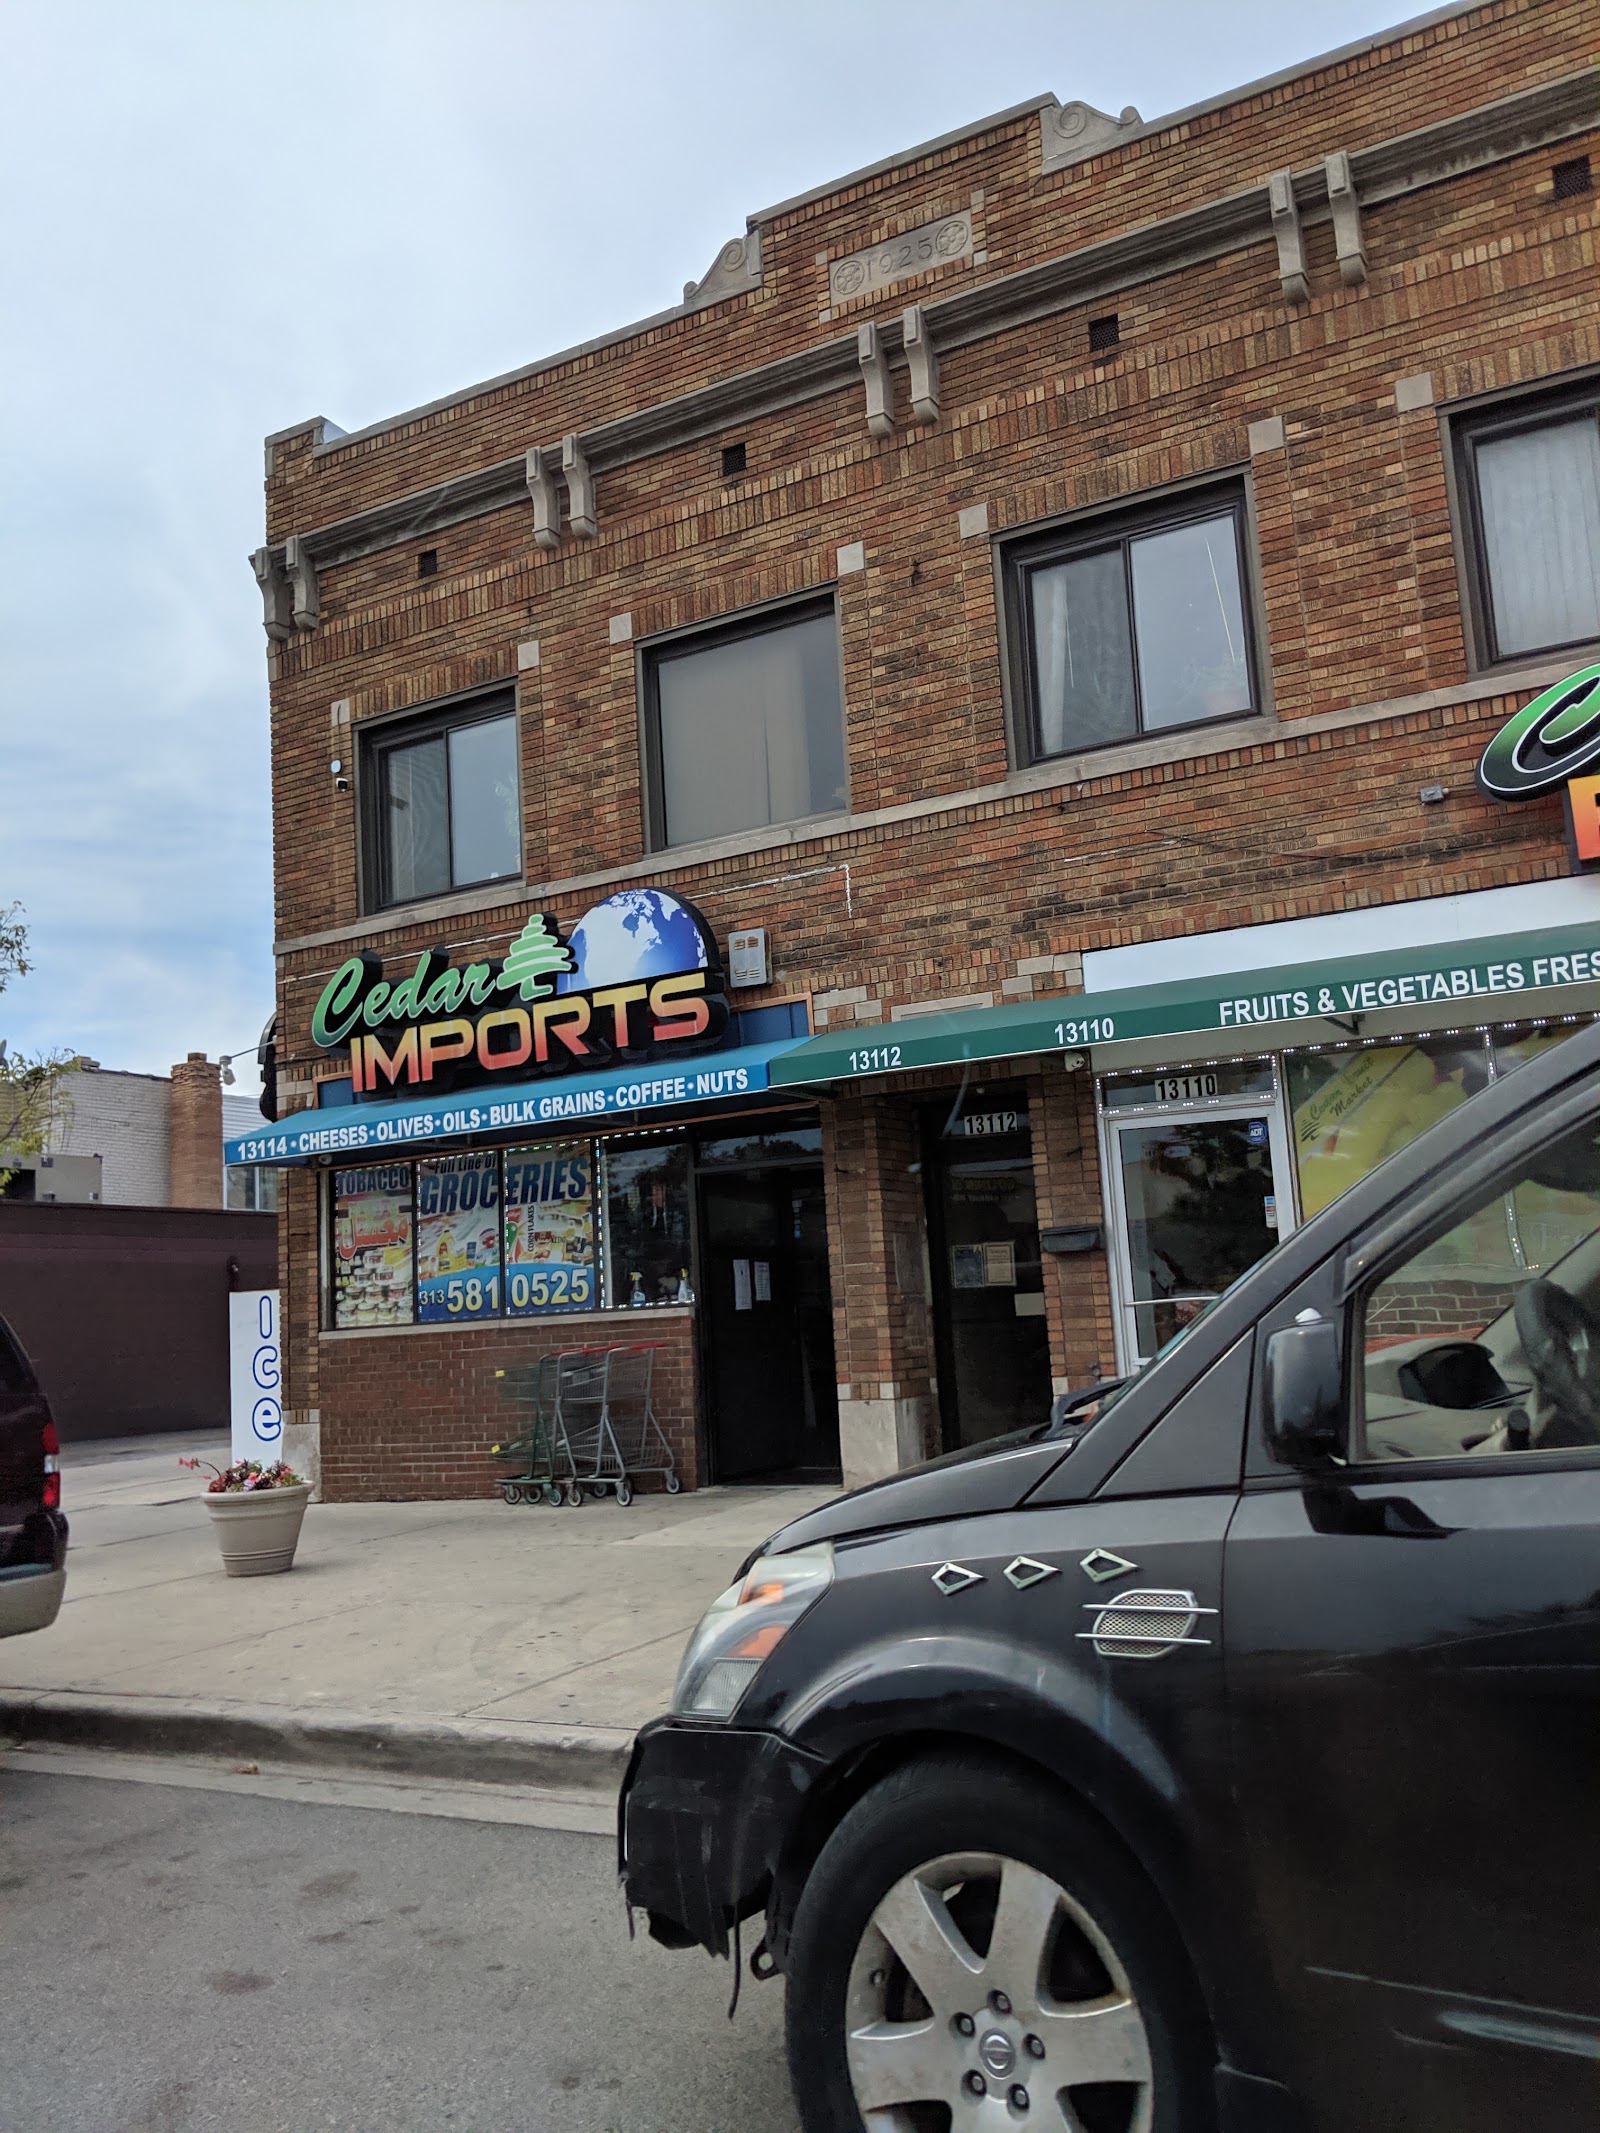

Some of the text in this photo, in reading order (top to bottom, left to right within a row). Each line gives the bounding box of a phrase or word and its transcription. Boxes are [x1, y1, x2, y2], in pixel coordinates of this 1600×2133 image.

[865, 236, 934, 282] 1925
[312, 950, 497, 1048] Cedar
[1219, 990, 1310, 1026] FRUITS
[1317, 987, 1336, 1012] &
[1341, 962, 1526, 1010] VEGETABLES
[351, 971, 710, 1093] IMPORTS
[1054, 1017, 1115, 1045] 13110
[849, 1046, 902, 1072] 13112
[1157, 1074, 1216, 1101] 13110
[1329, 1076, 1374, 1117] Market
[237, 1068, 749, 1161] 13114 CHEESES OLIVES OILS BULK GRAINS COFFEE NUTS
[966, 1112, 1016, 1135] 13112
[1249, 1127, 1263, 1138] ADT
[336, 1165, 410, 1195] TOBACCO
[420, 1156, 589, 1216] GROCERIES
[435, 1158, 456, 1174] Full
[457, 1156, 482, 1172] Line
[420, 1268, 590, 1314] 313 581 0525
[251, 1295, 282, 1442] Ice
